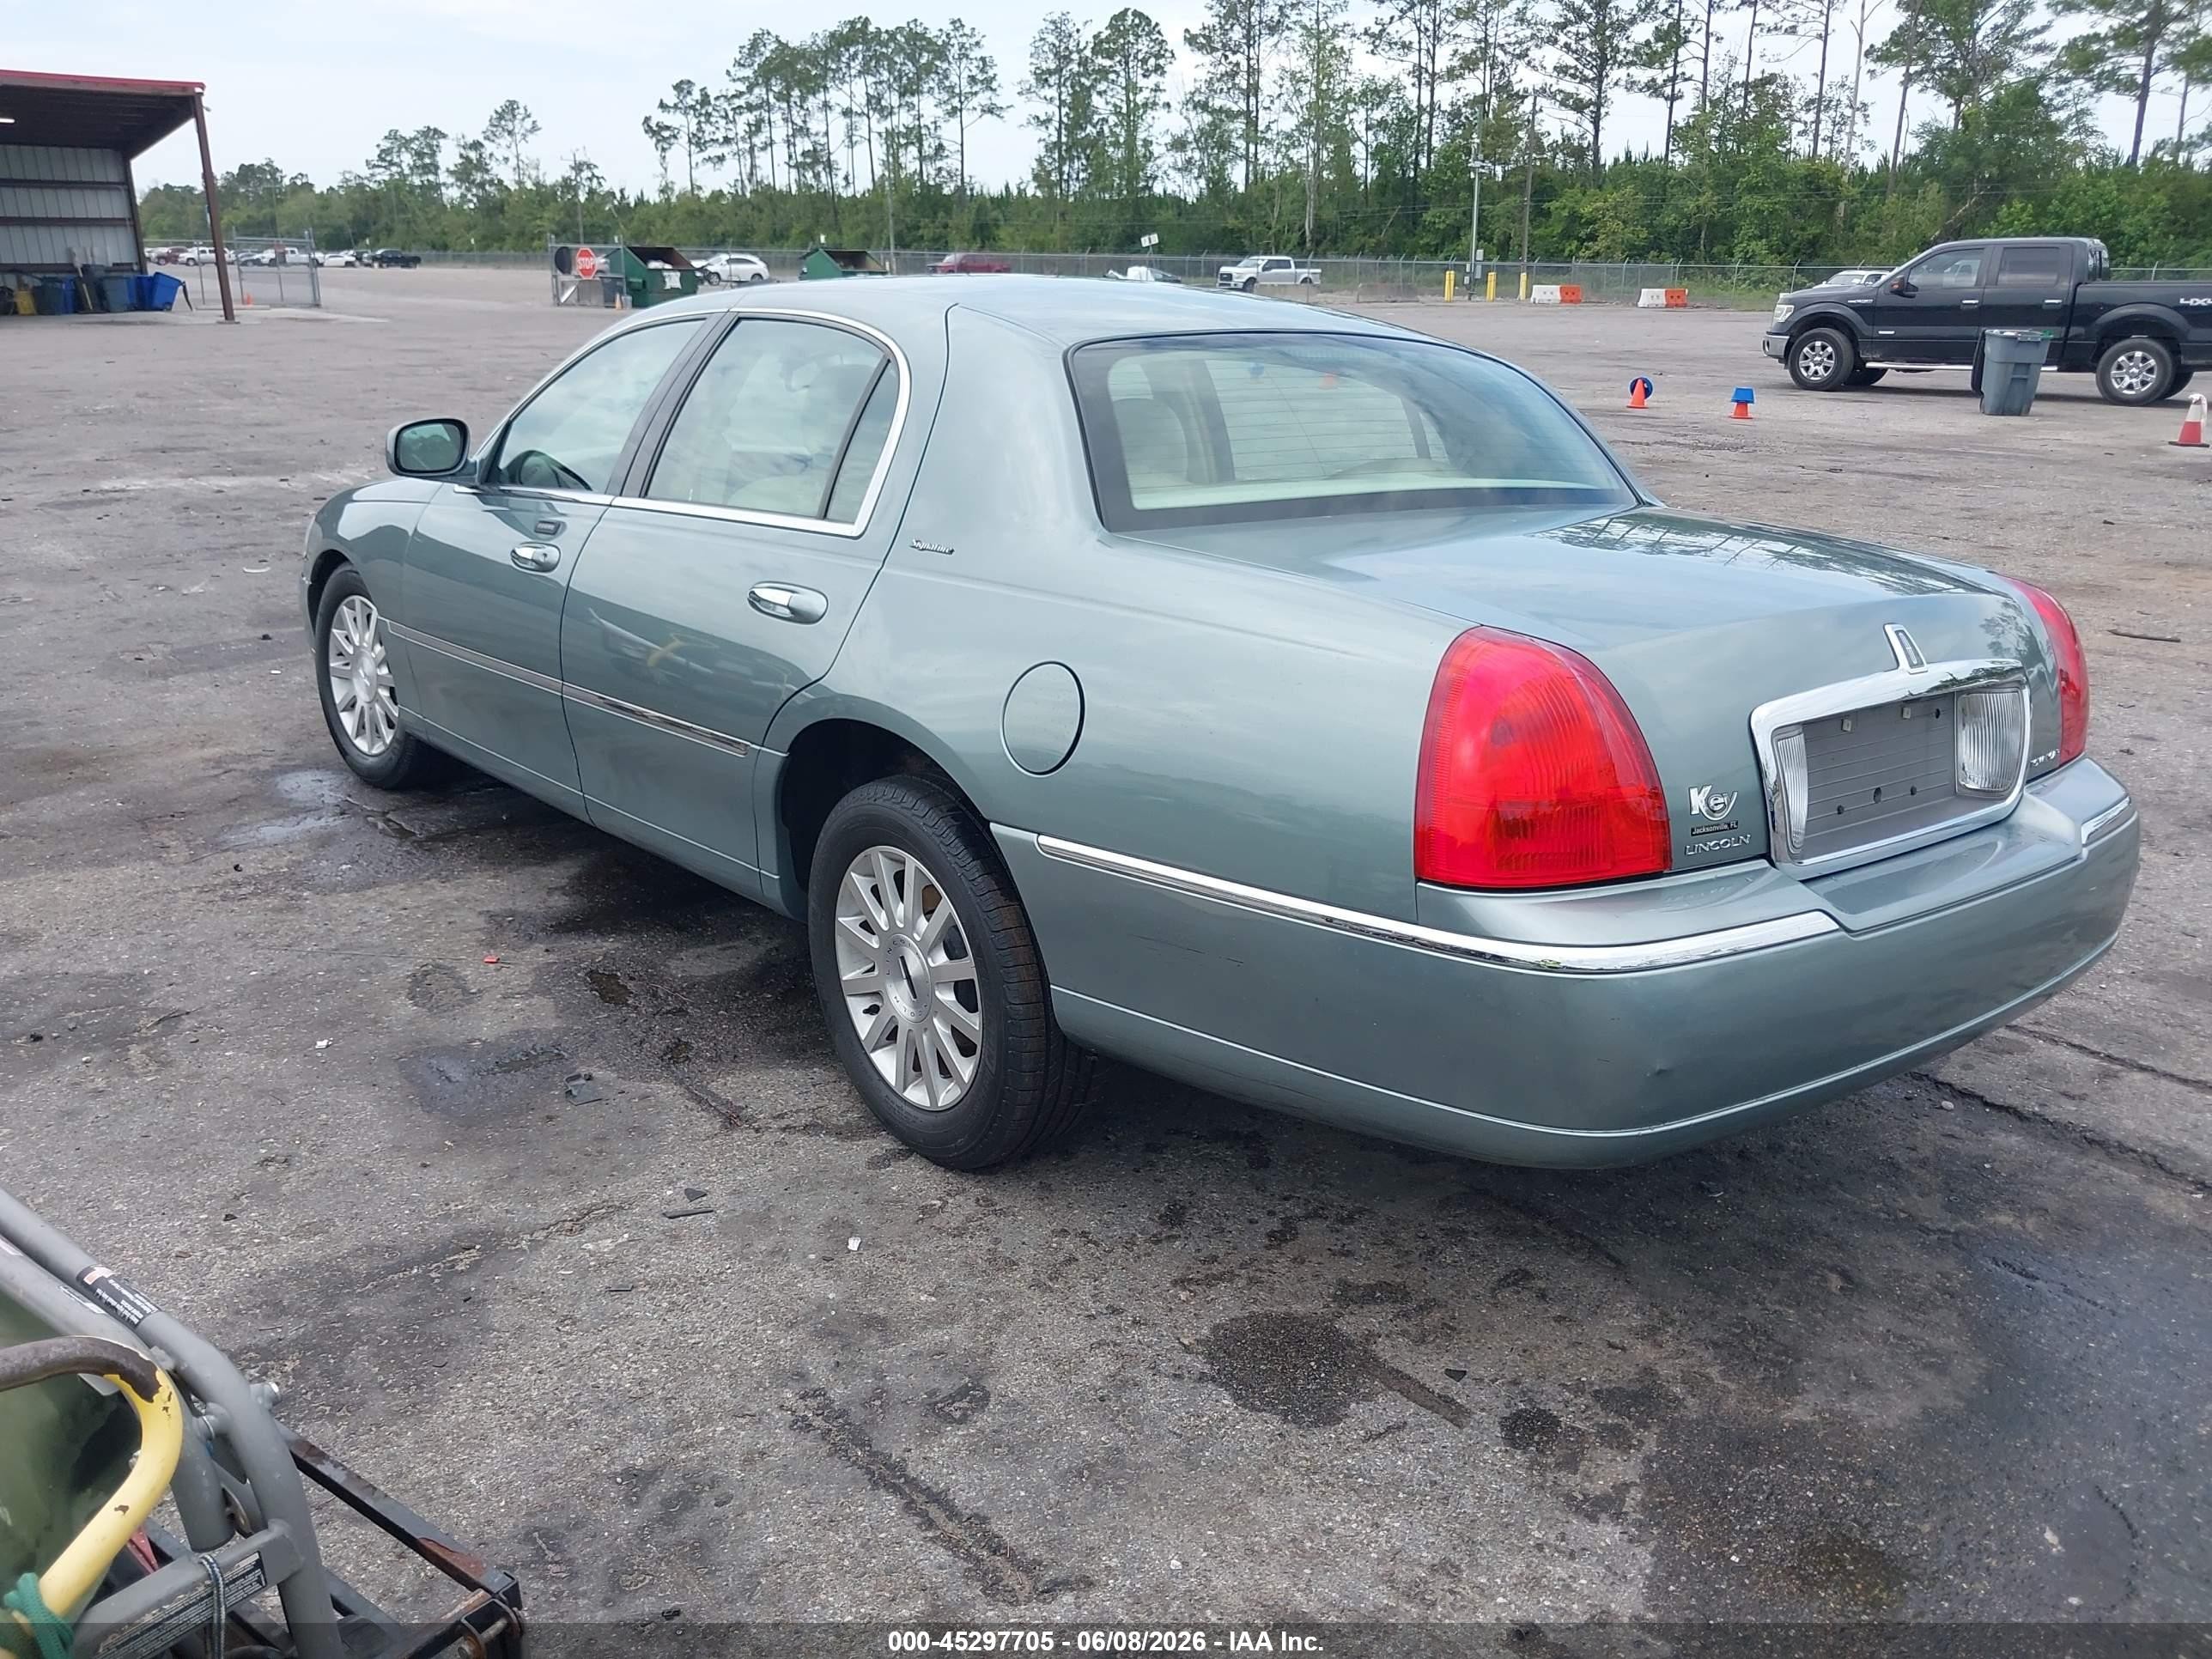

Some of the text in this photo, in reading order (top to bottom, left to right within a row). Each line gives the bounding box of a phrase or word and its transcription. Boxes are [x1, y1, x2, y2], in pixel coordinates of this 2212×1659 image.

[577, 257, 595, 270] STOP
[1689, 785, 1738, 821] Key
[1692, 820, 1738, 835] Jacksonville, FL
[1685, 834, 1751, 855] LINCOLN
